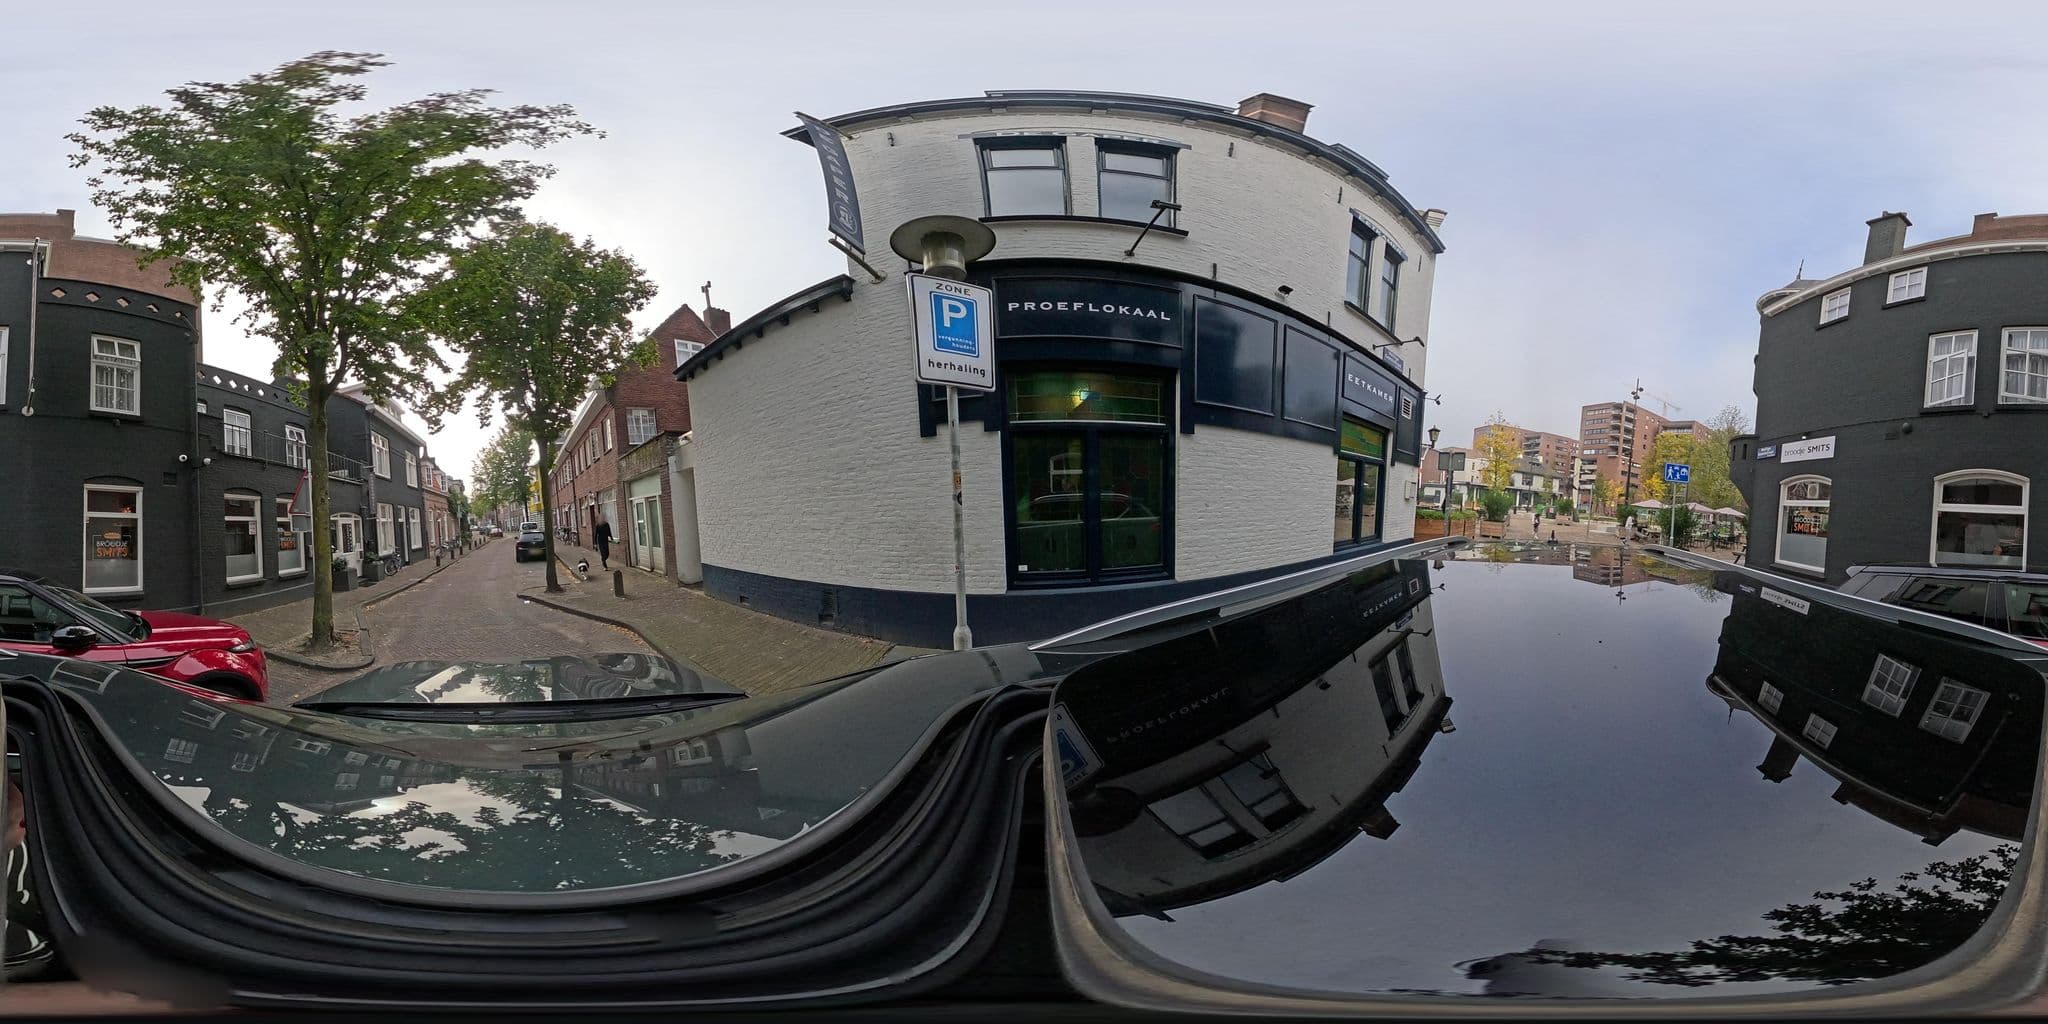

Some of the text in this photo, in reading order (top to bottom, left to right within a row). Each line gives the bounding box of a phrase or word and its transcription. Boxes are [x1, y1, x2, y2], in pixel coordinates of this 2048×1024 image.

[935, 282, 971, 296] ZONE
[942, 298, 968, 328] P
[1008, 301, 1171, 321] PROEFLOKAAL
[928, 358, 986, 378] herhaling
[1347, 373, 1394, 403] EETKAMER
[1807, 443, 1831, 454] SMITS
[96, 547, 128, 557] SMITS
